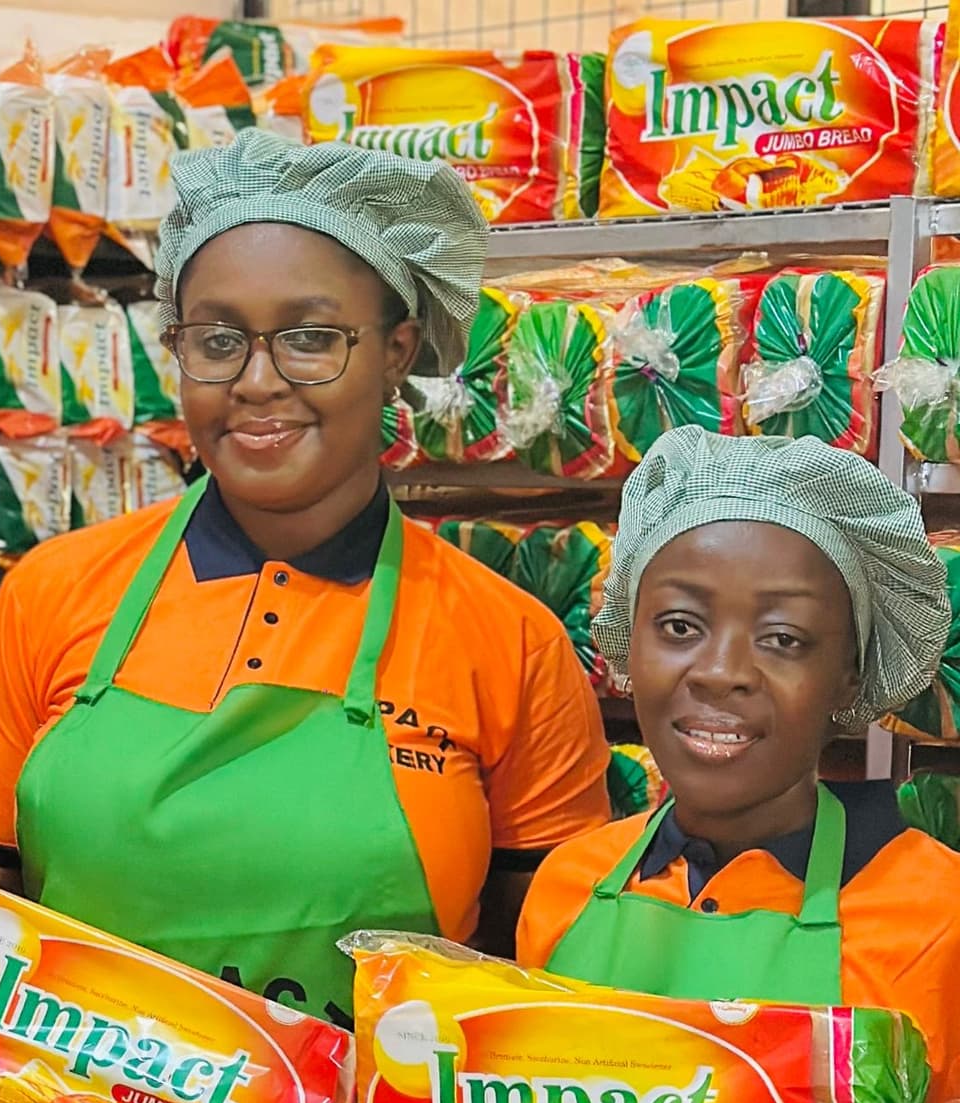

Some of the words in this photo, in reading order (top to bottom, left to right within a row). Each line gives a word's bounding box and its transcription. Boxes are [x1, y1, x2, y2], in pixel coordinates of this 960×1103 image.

[643, 51, 844, 148] Impact
[761, 131, 815, 151] JUMBO
[818, 127, 873, 146] BREAD
